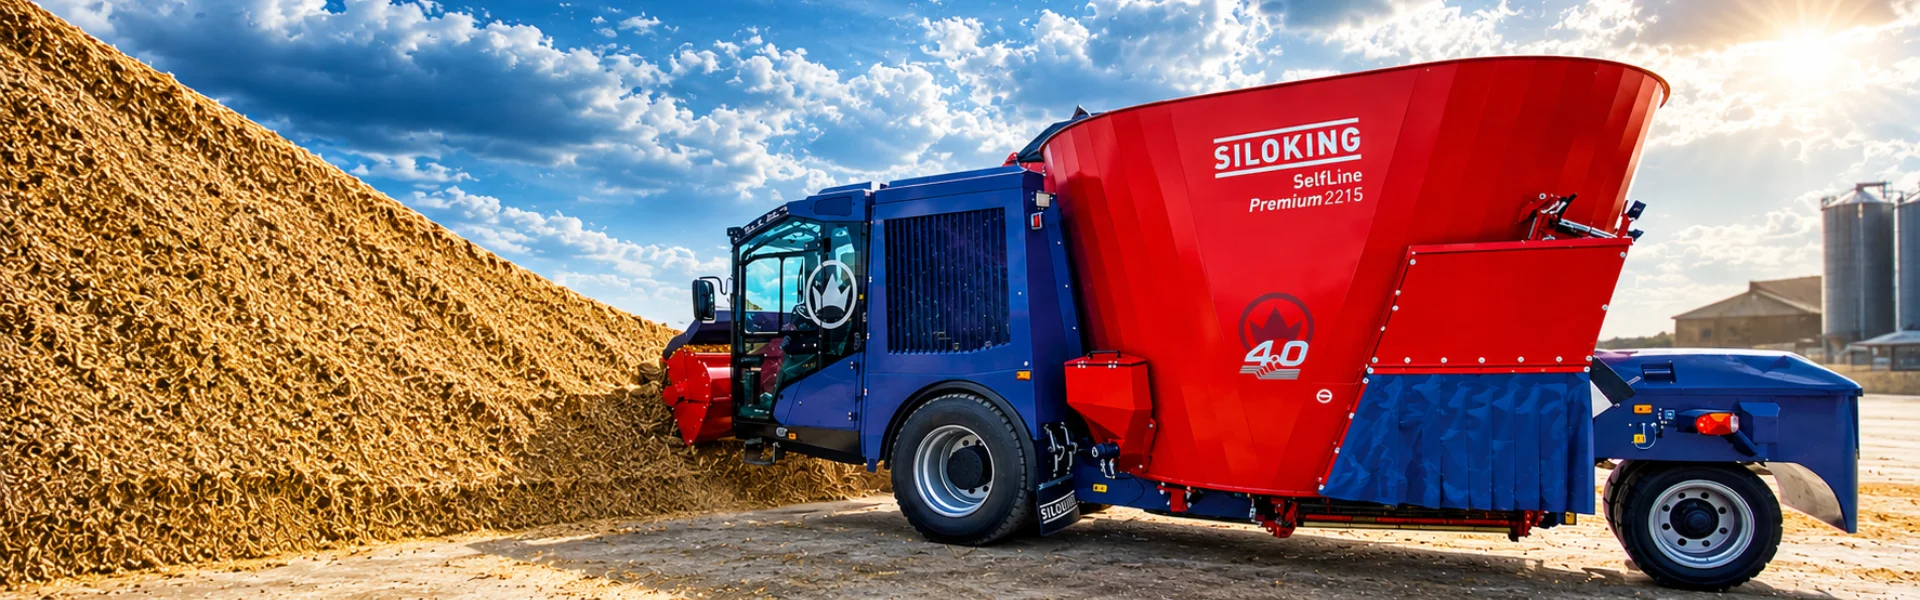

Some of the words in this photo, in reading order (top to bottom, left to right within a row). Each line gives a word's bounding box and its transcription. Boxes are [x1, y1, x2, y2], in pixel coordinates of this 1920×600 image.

[1214, 127, 1361, 170] SILOKING
[1293, 169, 1363, 189] SelfLine
[1249, 194, 1322, 213] Premium
[1324, 187, 1364, 205] 2215
[1244, 340, 1309, 367] 4.0
